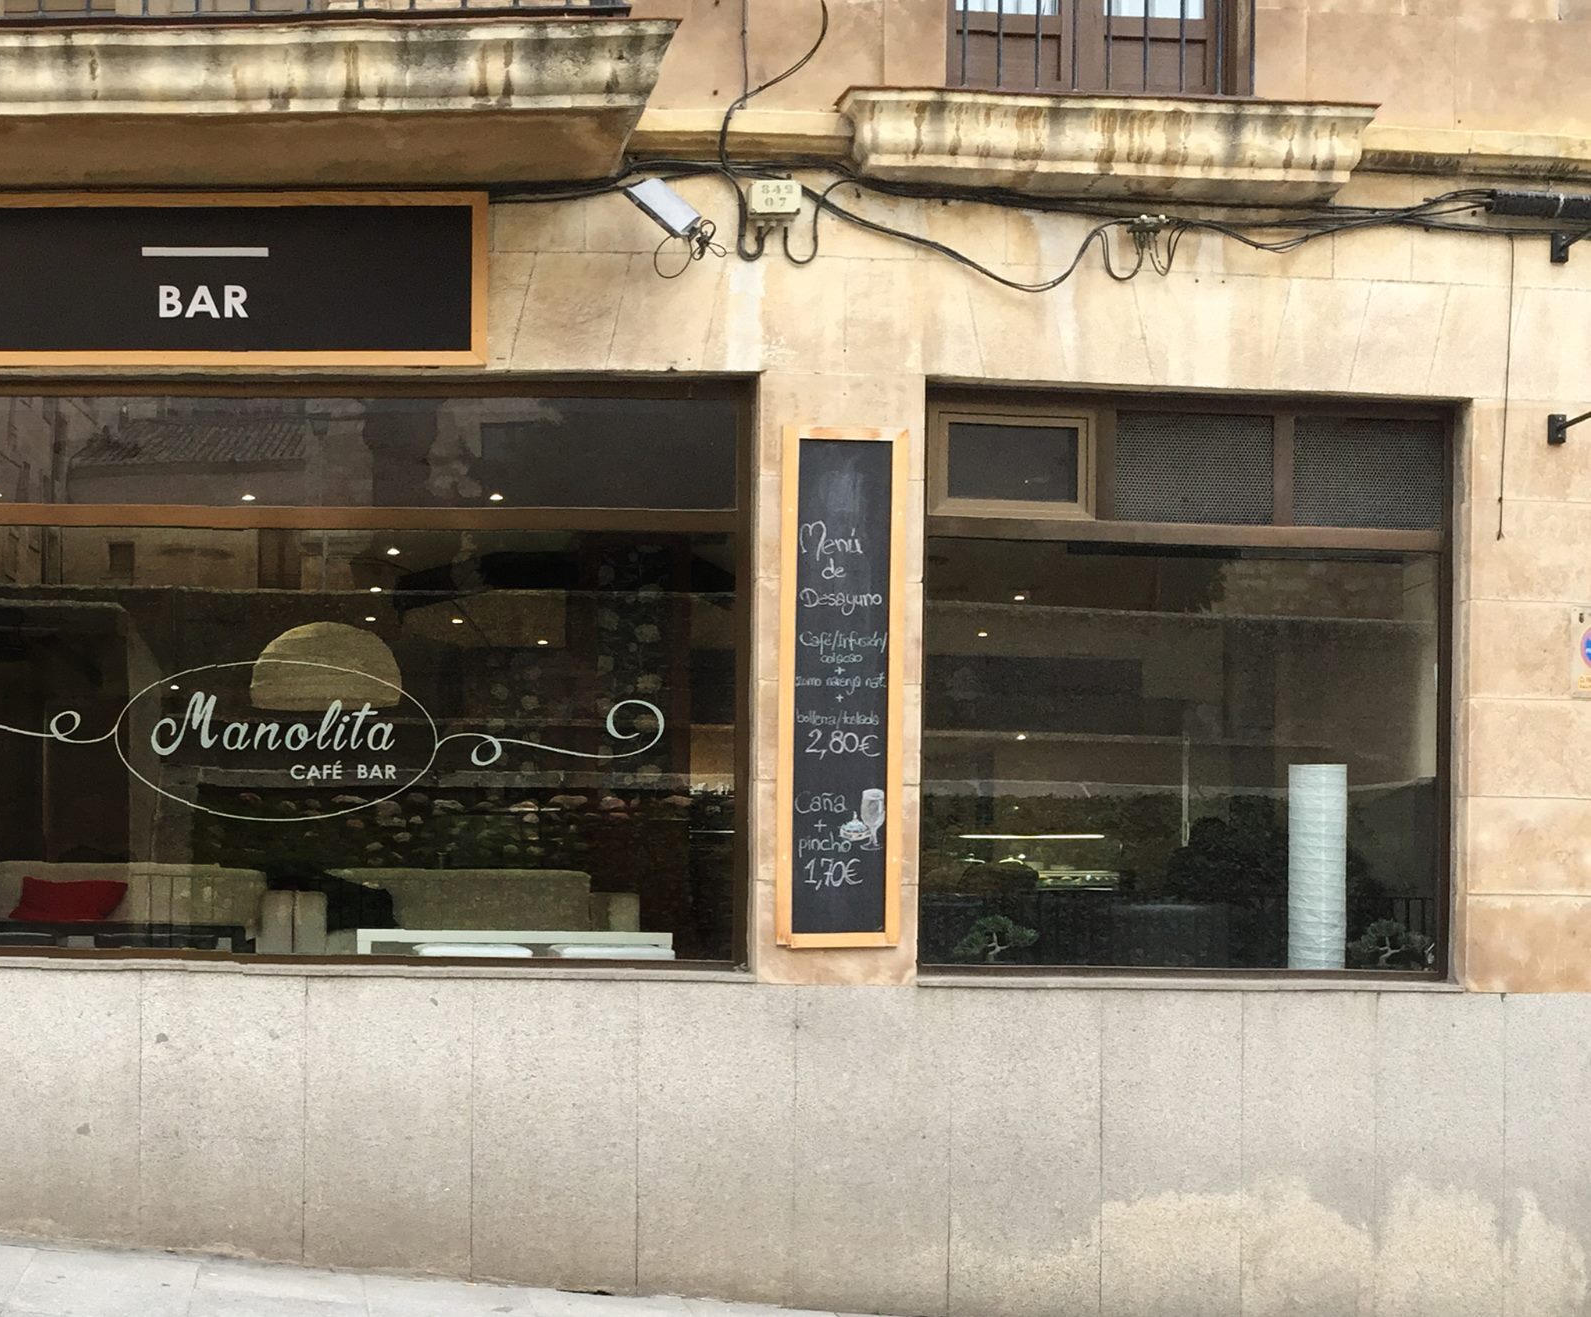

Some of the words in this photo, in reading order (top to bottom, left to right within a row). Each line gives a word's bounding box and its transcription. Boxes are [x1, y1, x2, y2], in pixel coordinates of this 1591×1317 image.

[157, 284, 250, 320] BAR
[799, 520, 864, 561] Menú
[821, 557, 847, 580] de
[799, 587, 883, 616] Desayuno
[151, 691, 396, 756] Manolita
[805, 728, 881, 760] 2,80€
[290, 760, 342, 780] CAFÉ
[357, 764, 396, 780] BAR
[794, 790, 848, 814] Caña
[798, 831, 852, 858] pincho
[804, 857, 864, 891] 1,70€
